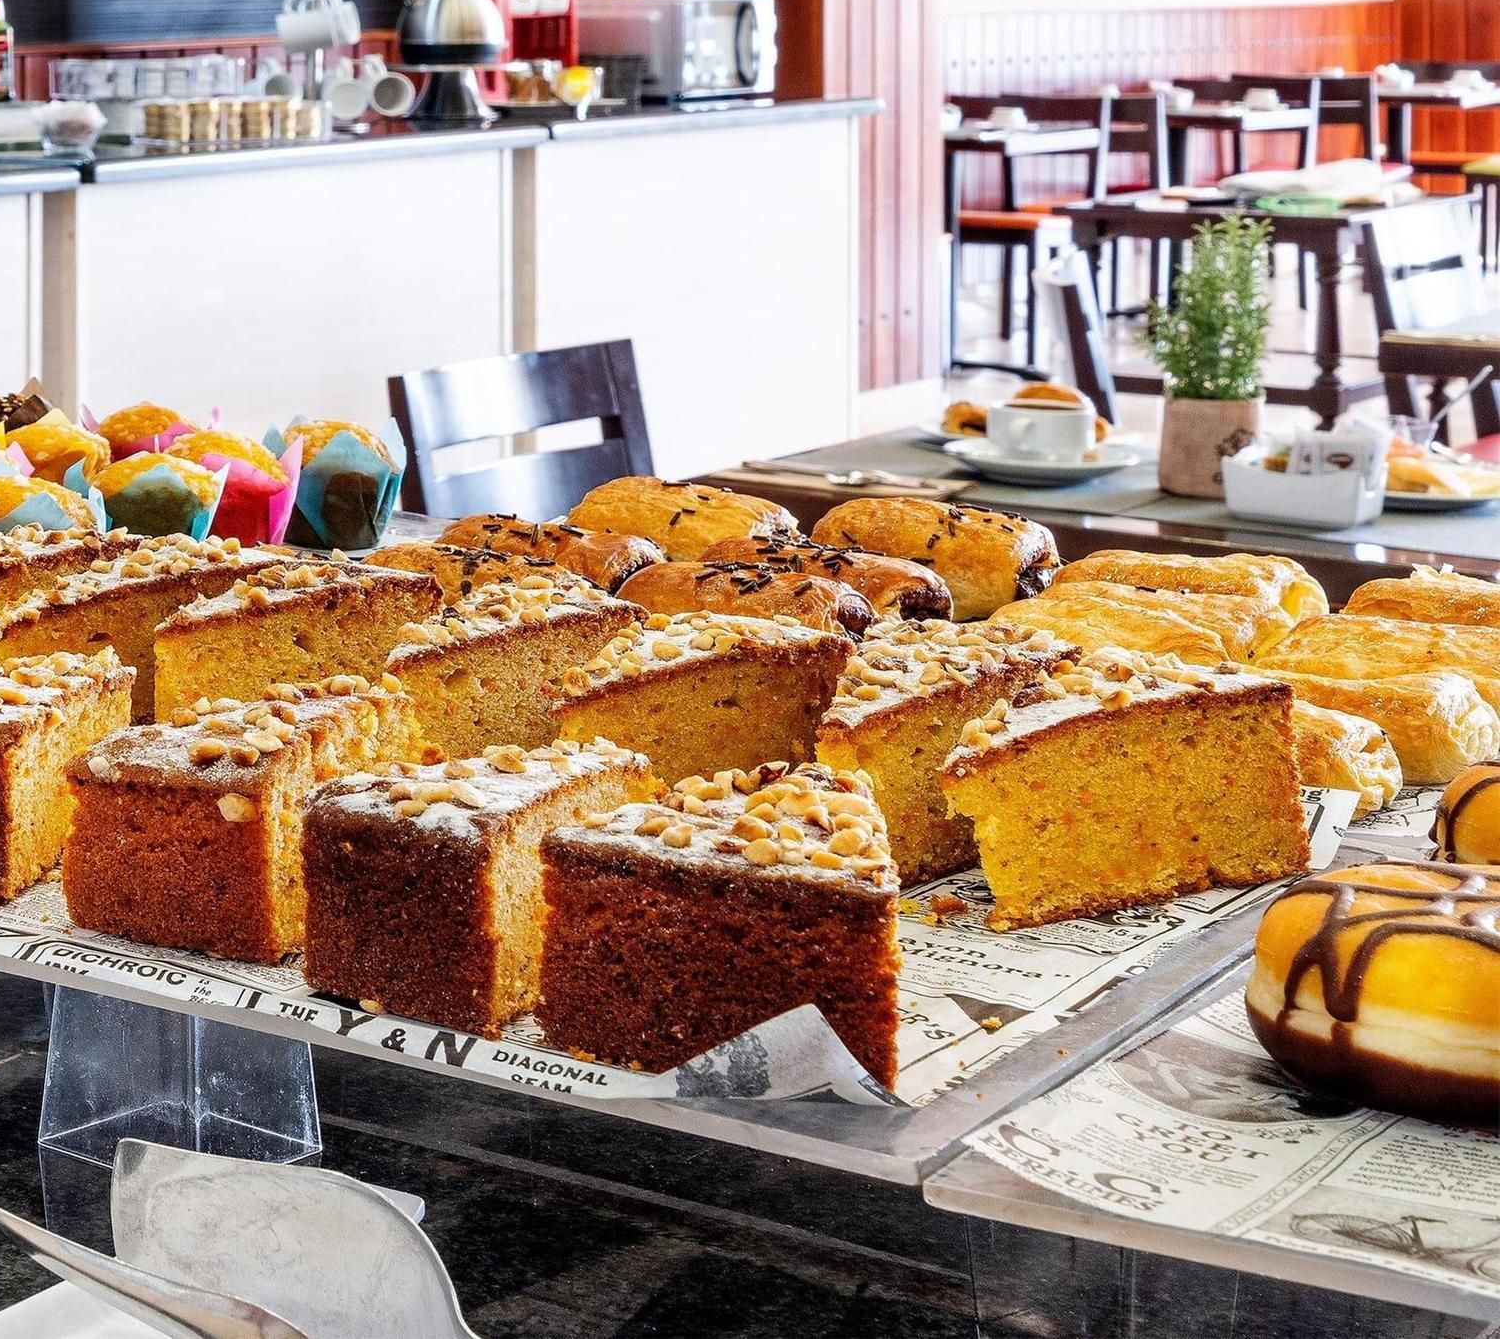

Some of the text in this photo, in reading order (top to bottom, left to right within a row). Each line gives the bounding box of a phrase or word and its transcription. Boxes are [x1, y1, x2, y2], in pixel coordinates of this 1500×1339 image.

[51, 948, 187, 986] DICHROIC
[193, 986, 211, 996] the
[381, 1028, 406, 1052] &
[425, 1030, 477, 1068] N
[491, 1049, 609, 1087] DIAGONAL
[1172, 1119, 1233, 1141] TO
